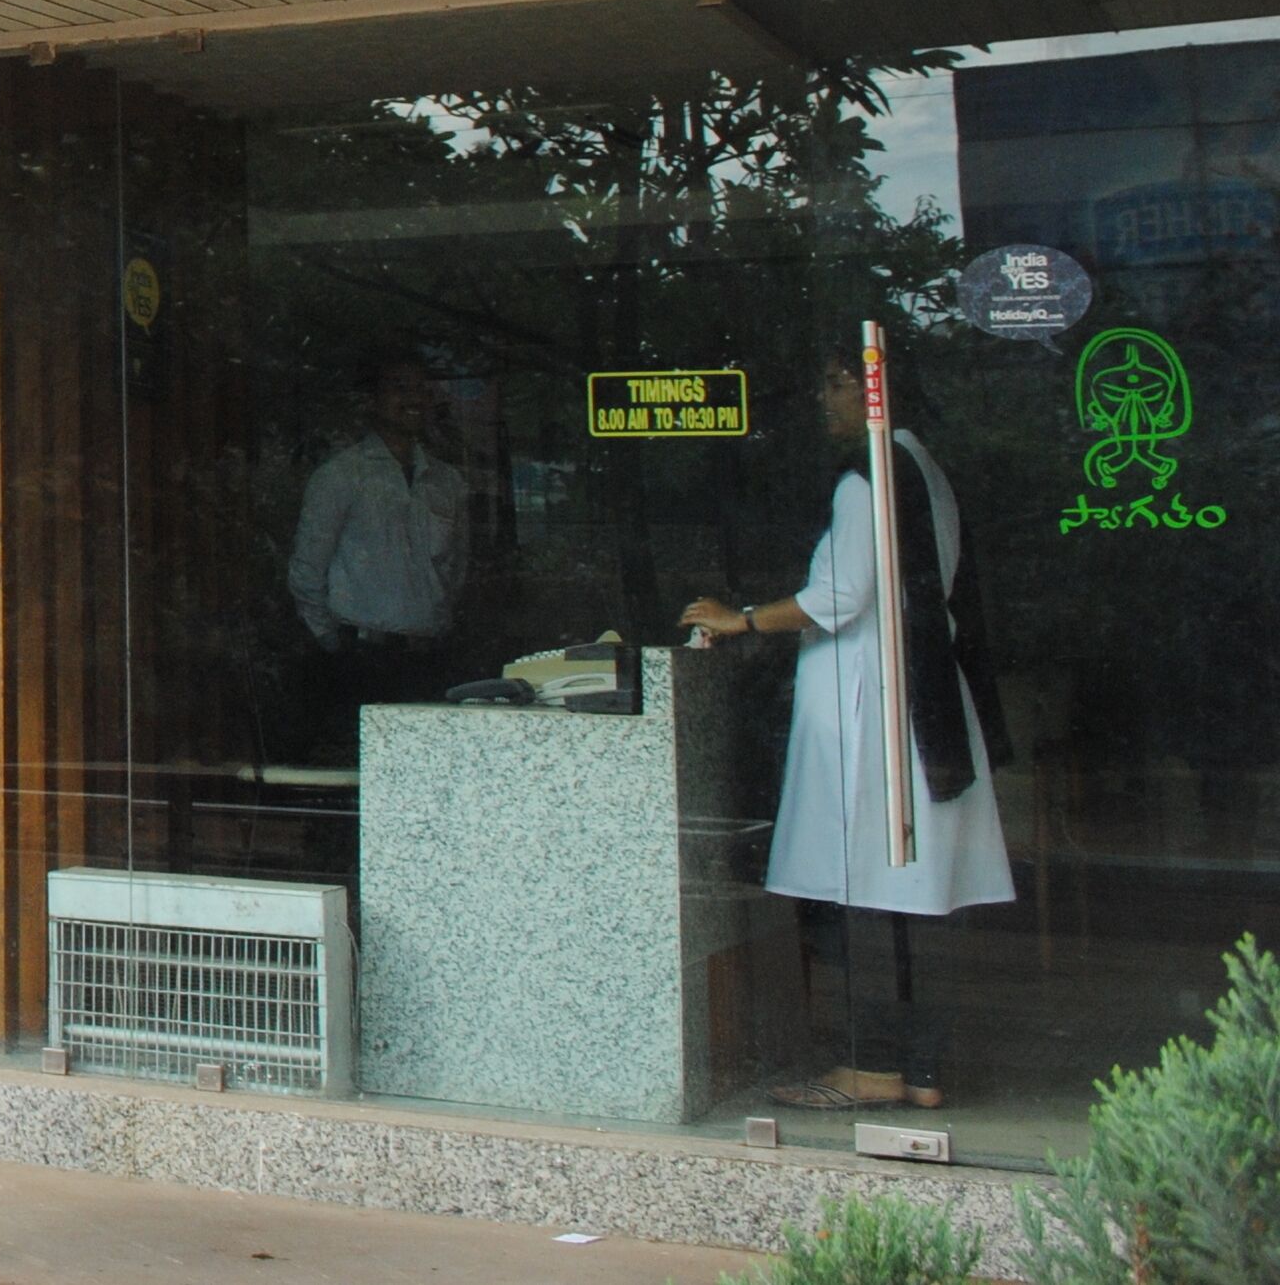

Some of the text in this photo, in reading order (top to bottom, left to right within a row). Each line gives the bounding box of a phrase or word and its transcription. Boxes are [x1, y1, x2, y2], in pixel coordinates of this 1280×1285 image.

[1005, 252, 1048, 267] India
[1007, 271, 1050, 290] YES
[627, 377, 706, 403] TIMINGS
[865, 363, 883, 418] PUSH
[627, 407, 649, 430] AM
[654, 407, 674, 429] TO
[717, 406, 739, 429] PM
